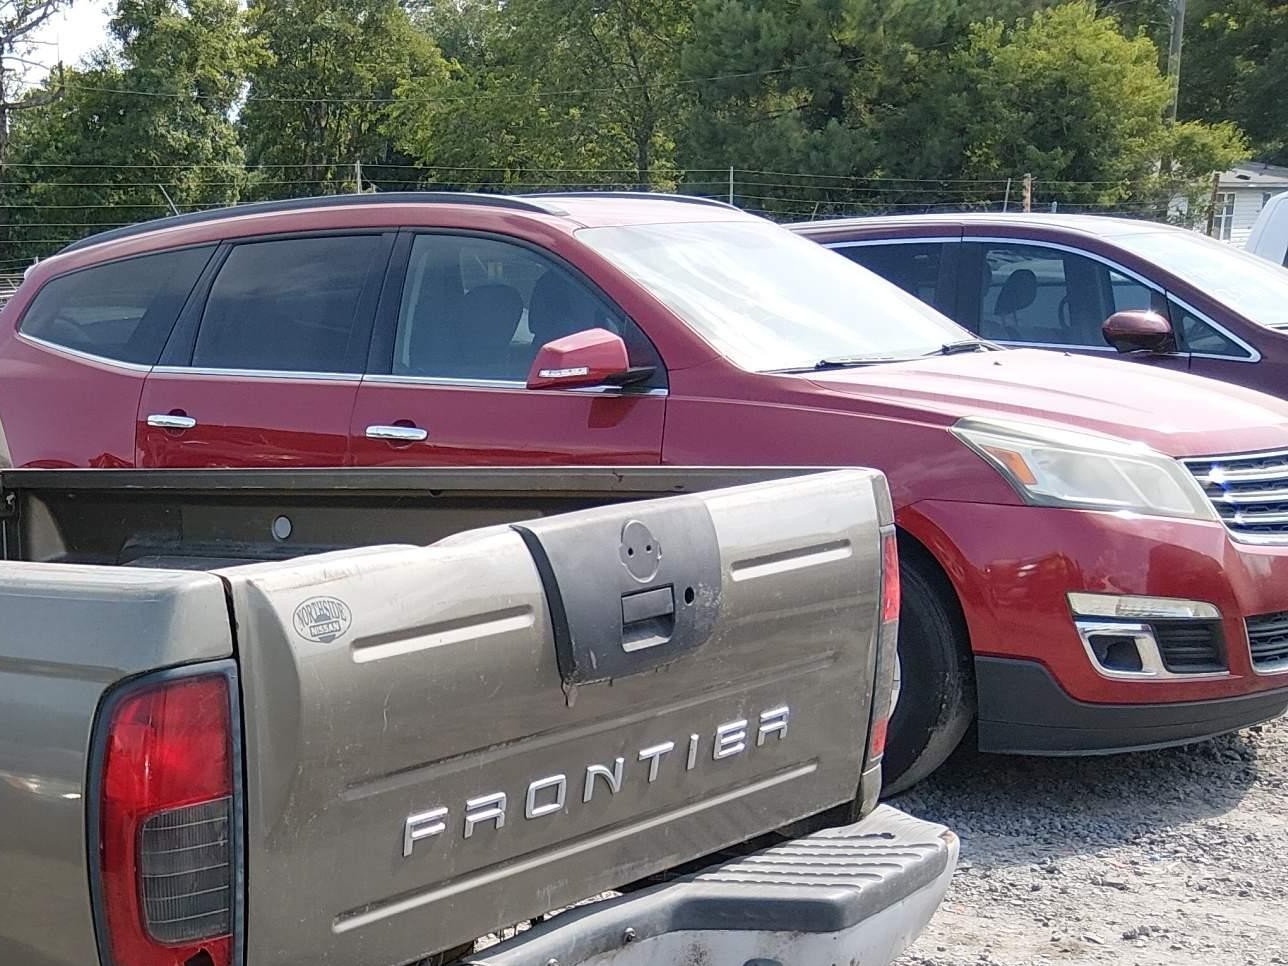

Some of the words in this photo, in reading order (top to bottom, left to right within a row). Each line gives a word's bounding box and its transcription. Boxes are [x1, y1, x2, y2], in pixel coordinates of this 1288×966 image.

[296, 600, 347, 631] NORTHSIDE
[312, 622, 340, 635] NISSAN
[403, 706, 790, 857] FRONTIER
